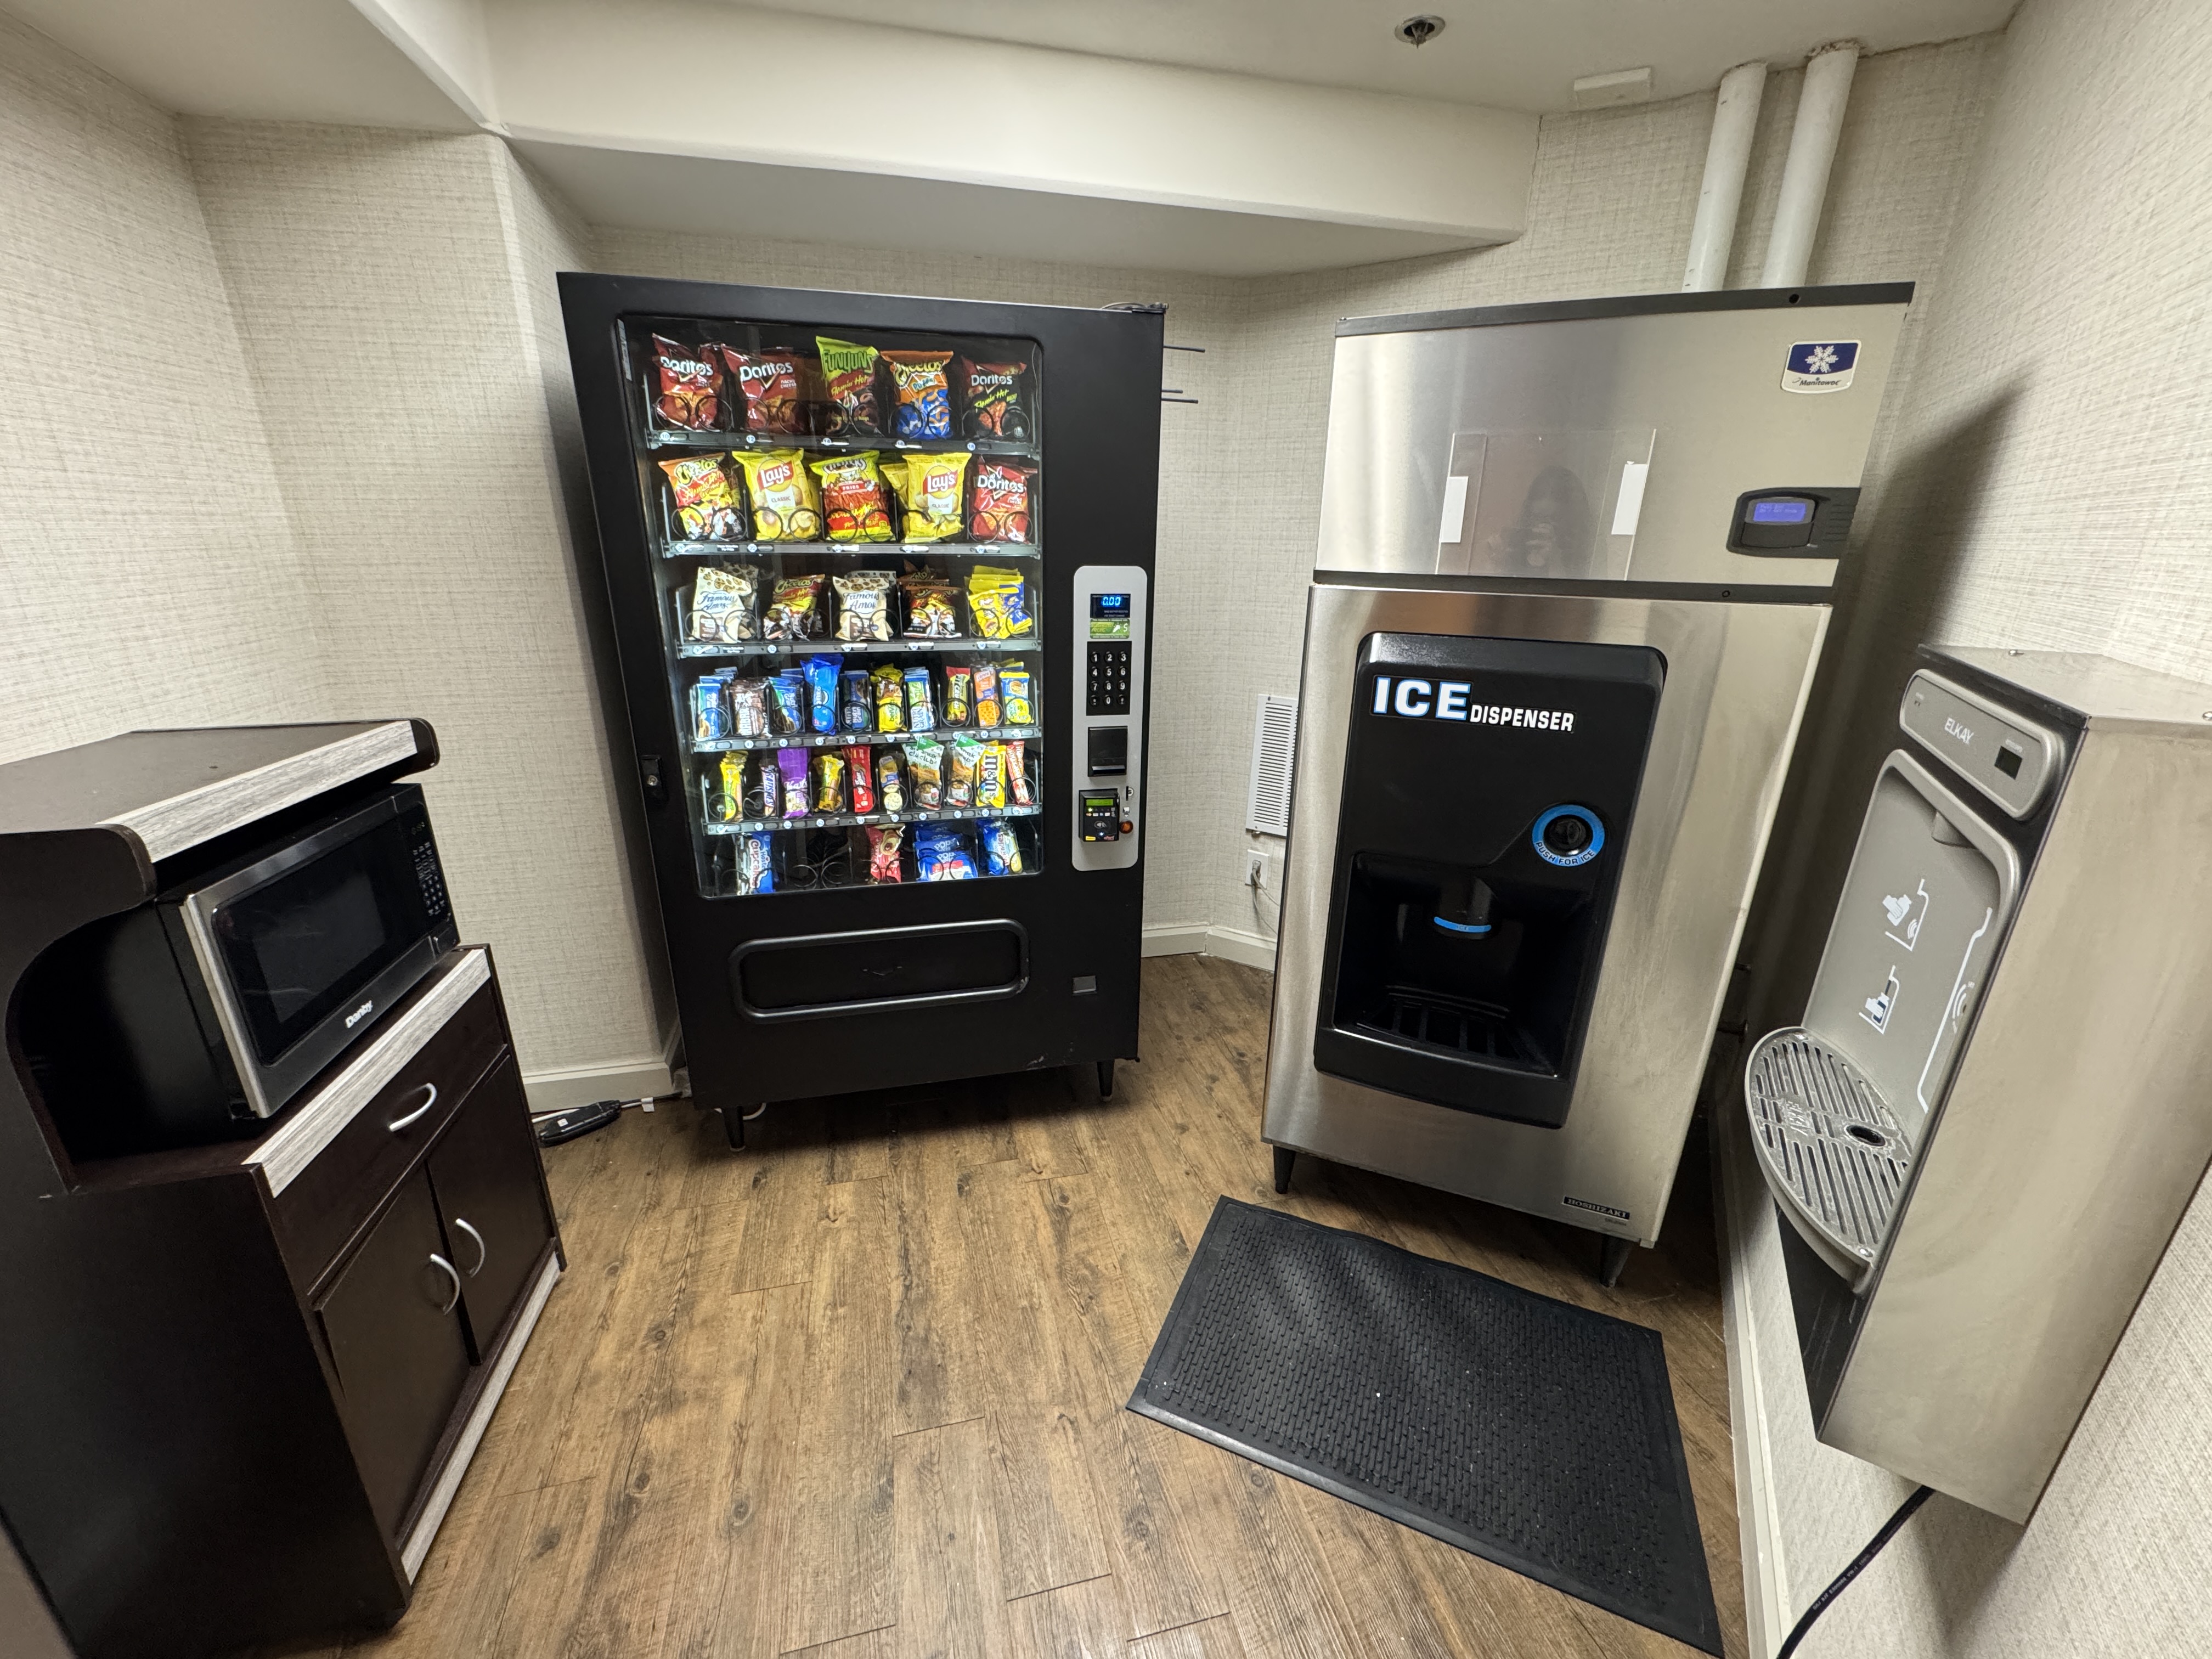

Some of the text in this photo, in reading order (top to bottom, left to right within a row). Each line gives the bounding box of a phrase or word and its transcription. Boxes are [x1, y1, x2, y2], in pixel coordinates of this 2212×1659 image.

[661, 356, 713, 376] Doritos
[740, 362, 793, 381] Doritos
[971, 374, 1013, 386] Doritos
[1799, 377, 1842, 386] Manitowoc
[760, 464, 791, 487] Lay's
[927, 472, 956, 493] Lay's
[977, 475, 1024, 493] Doritos
[1093, 653, 1126, 662] 1 2 3
[953, 674, 962, 710] FITCRUCH
[1373, 676, 1575, 732] ICE DISPENSER
[1944, 717, 1974, 745] ELKAY
[1536, 842, 1556, 861] PUSH
[1581, 850, 1595, 862] ICE
[1567, 1198, 1627, 1218] HOSHIZAKI
